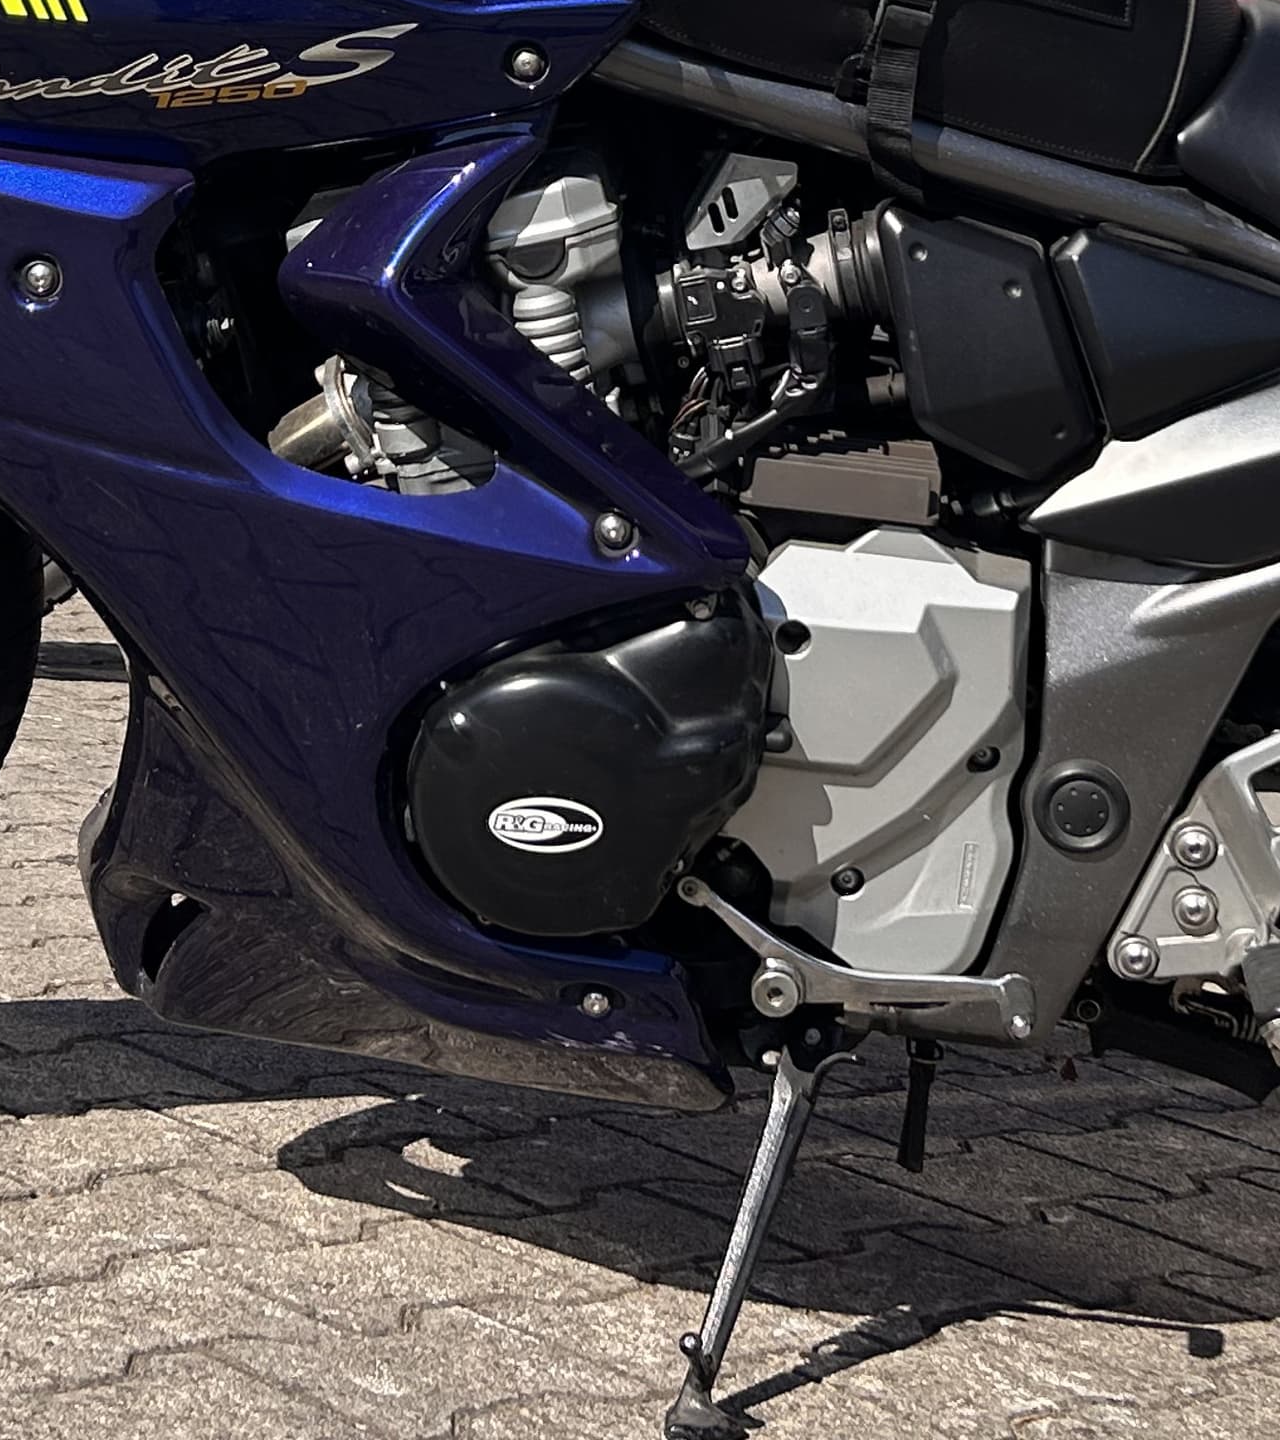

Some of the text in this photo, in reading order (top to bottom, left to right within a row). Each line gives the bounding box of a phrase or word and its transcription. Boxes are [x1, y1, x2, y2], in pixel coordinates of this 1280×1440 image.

[264, 23, 420, 89] S
[153, 79, 308, 110] 1250
[493, 812, 546, 834] R&G
